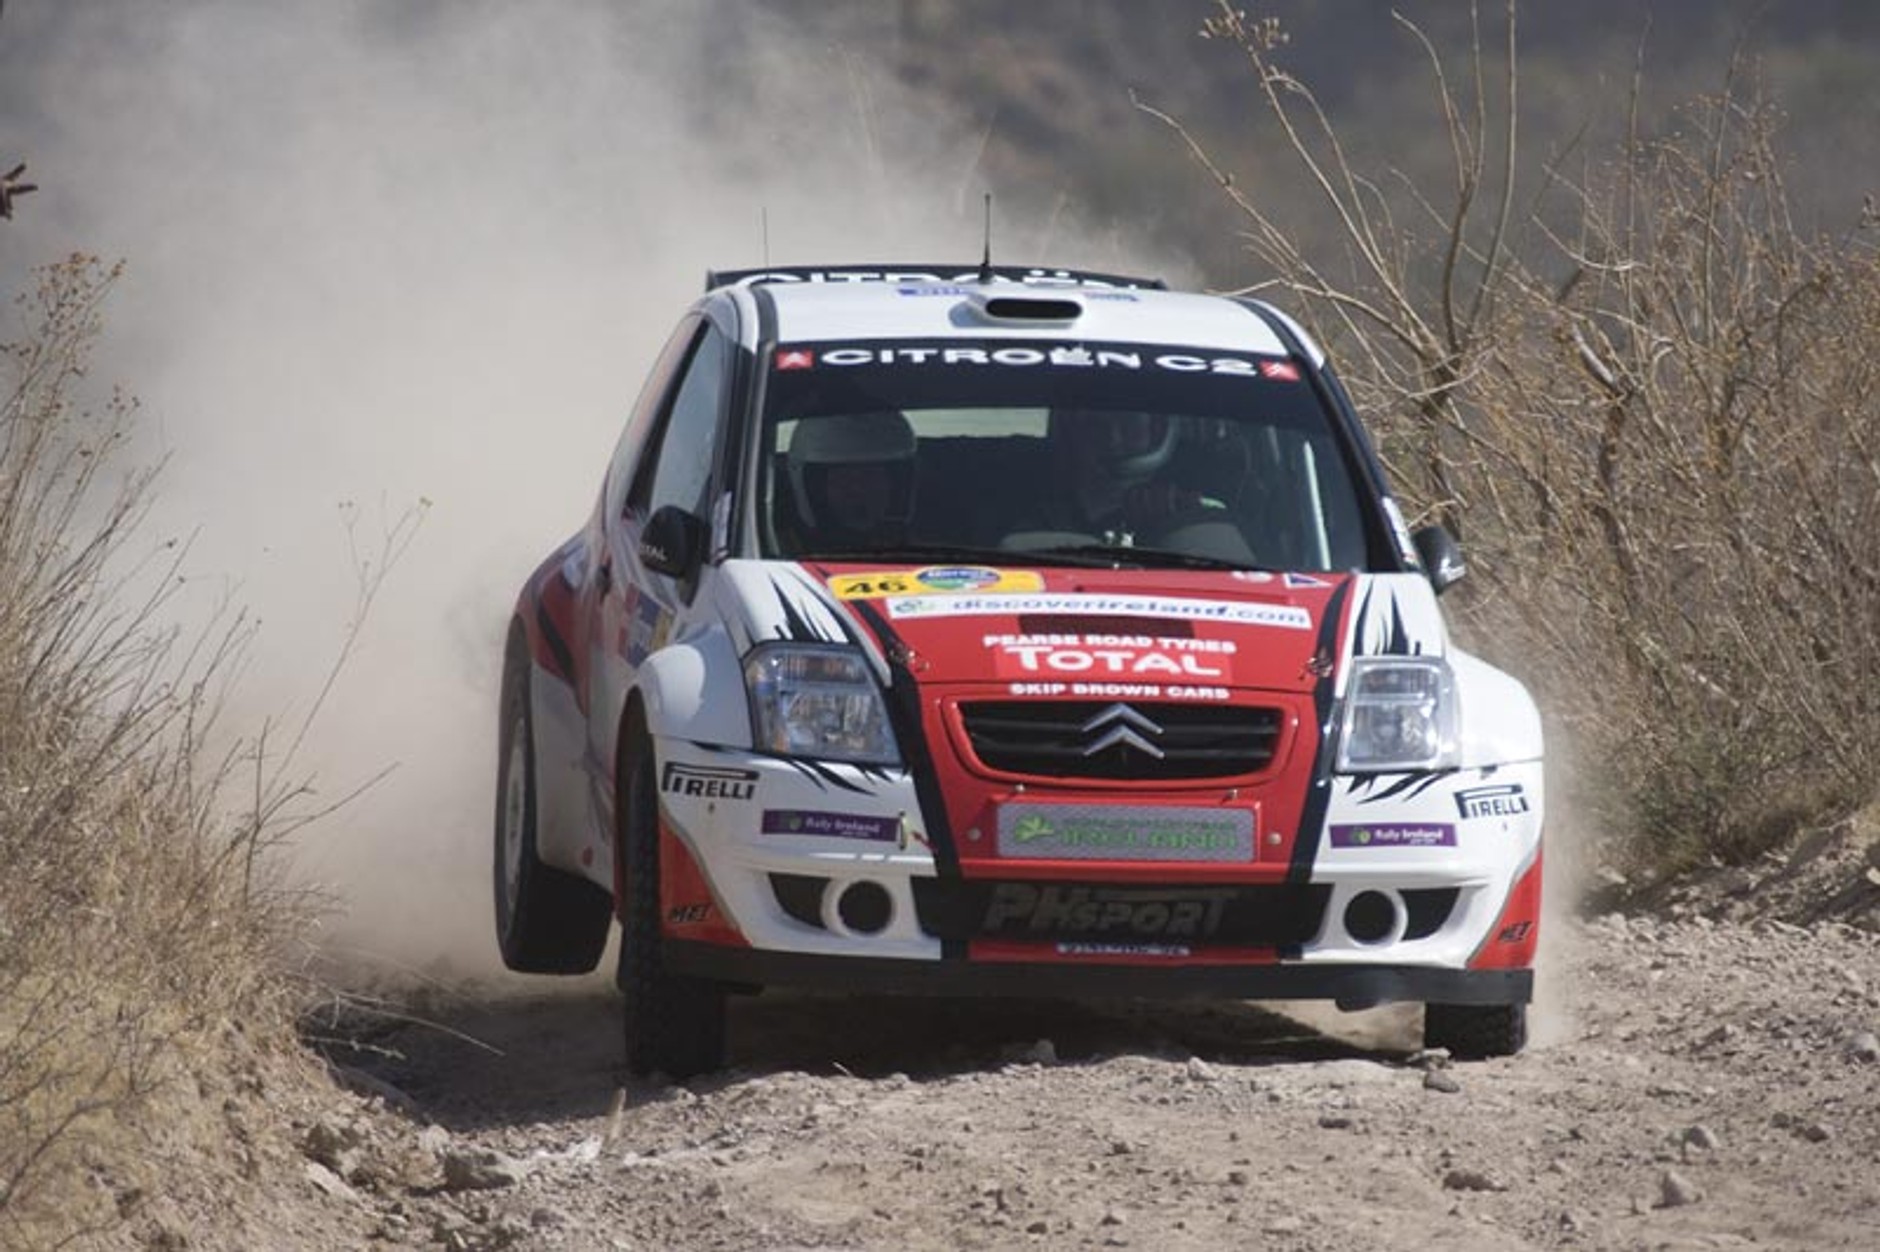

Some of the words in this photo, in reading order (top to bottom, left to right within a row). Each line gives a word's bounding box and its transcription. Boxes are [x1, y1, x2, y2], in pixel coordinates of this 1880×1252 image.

[821, 343, 1141, 369] CITROËN
[1155, 354, 1257, 377] C2
[845, 580, 908, 594] 46
[953, 598, 1306, 626] discoverireland.com
[983, 634, 1080, 648] PEARSE
[1084, 634, 1153, 648] ROAD
[1156, 637, 1237, 653] TYRES
[1003, 645, 1221, 676] TOTAL
[1010, 683, 1066, 697] SKIP
[1072, 683, 1160, 697] BROWN
[1165, 685, 1230, 699] CARS
[661, 761, 760, 800] PIRELLI
[1452, 784, 1530, 819] PIRELLI
[805, 817, 832, 833] Rally
[834, 818, 880, 834] Ireland
[1374, 828, 1400, 842] Rally
[1402, 827, 1445, 840] Ireland
